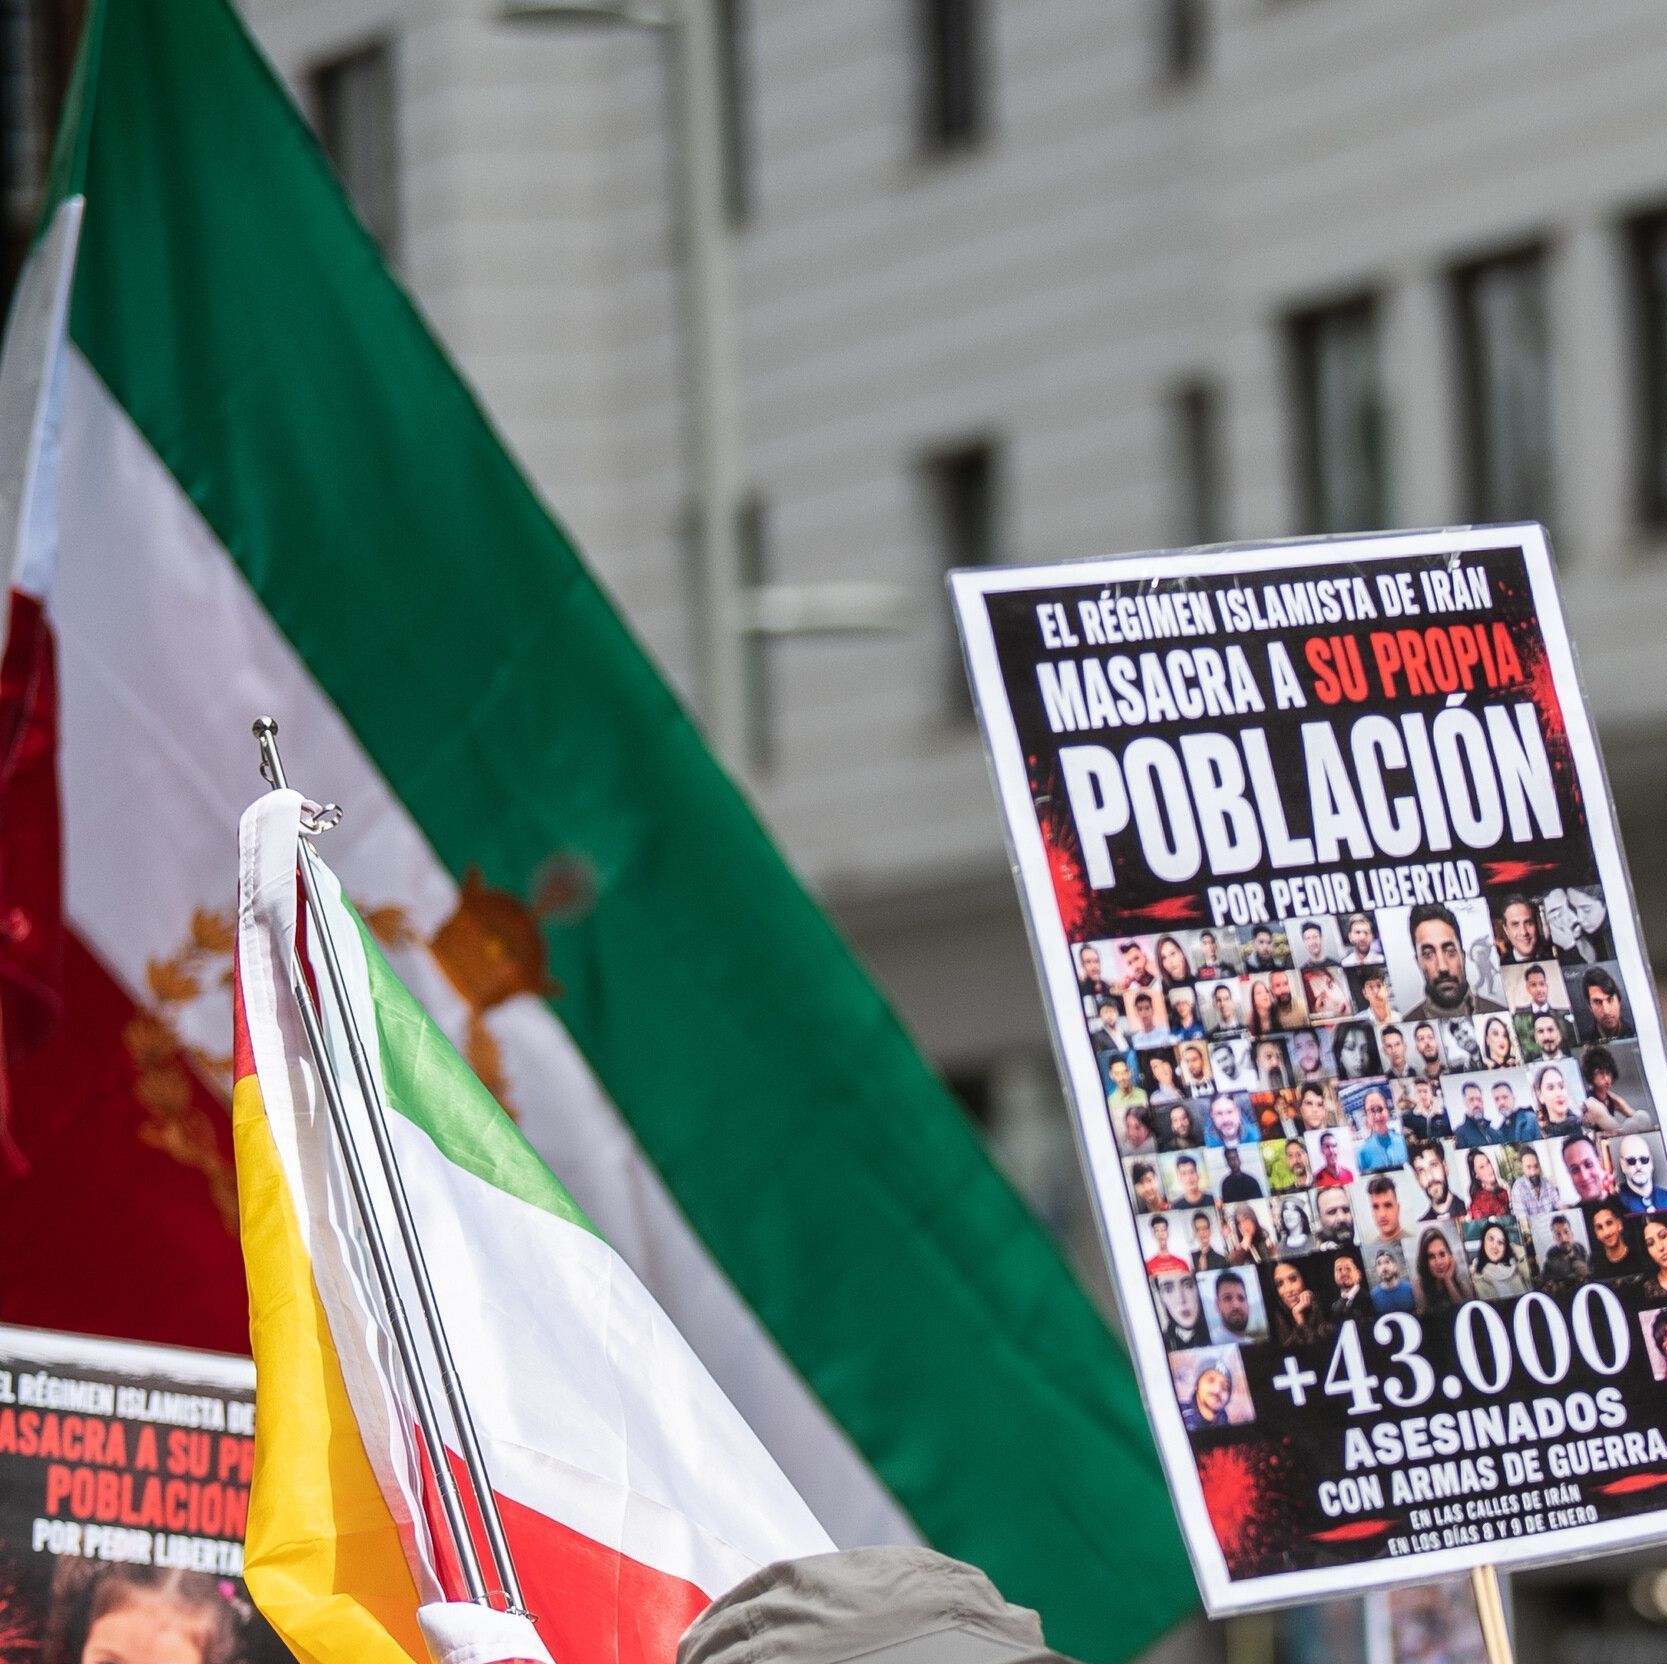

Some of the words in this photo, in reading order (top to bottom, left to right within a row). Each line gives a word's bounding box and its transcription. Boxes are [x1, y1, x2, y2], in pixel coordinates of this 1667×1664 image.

[1036, 603, 1078, 649] EL
[1079, 590, 1217, 646] RÉGIMEN
[1219, 575, 1377, 634] ISLAMISTA
[1383, 575, 1419, 617] DE
[1420, 559, 1493, 614] IRÁN
[1036, 644, 1266, 733] MASACRA
[1268, 641, 1307, 709] A
[1305, 632, 1369, 705] SU
[1370, 622, 1524, 697] PROPIA
[1058, 693, 1564, 890] POBLACIÓN
[1207, 879, 1270, 927] POR
[1273, 872, 1357, 921] PEDIR
[1357, 859, 1481, 912] LIBERTAD
[1272, 1282, 1633, 1416] +43.000
[0, 1407, 127, 1468] ASACRA
[134, 1425, 158, 1472] A
[167, 1428, 211, 1480] SU
[1345, 1387, 1629, 1471] ASESINADOS
[1317, 1476, 1384, 1517] CON
[1392, 1460, 1499, 1506] ARMAS
[1504, 1452, 1545, 1485] DE
[1409, 1510, 1433, 1530] EN
[1435, 1503, 1465, 1527] LAS
[1466, 1493, 1521, 1522] CALLES
[1522, 1490, 1544, 1512] DE
[1545, 1482, 1582, 1507] IRÁN
[32, 1518, 82, 1558] POR
[153, 1531, 244, 1578] LIBERTA
[1387, 1537, 1411, 1557] EN
[1412, 1531, 1442, 1553] LOS
[1444, 1521, 1481, 1548] DÍAS
[1482, 1522, 1495, 1542] 8
[1496, 1520, 1510, 1538] Y
[1511, 1517, 1523, 1535] 9
[1524, 1513, 1546, 1534] DE
[1547, 1504, 1599, 1530] ENERO
